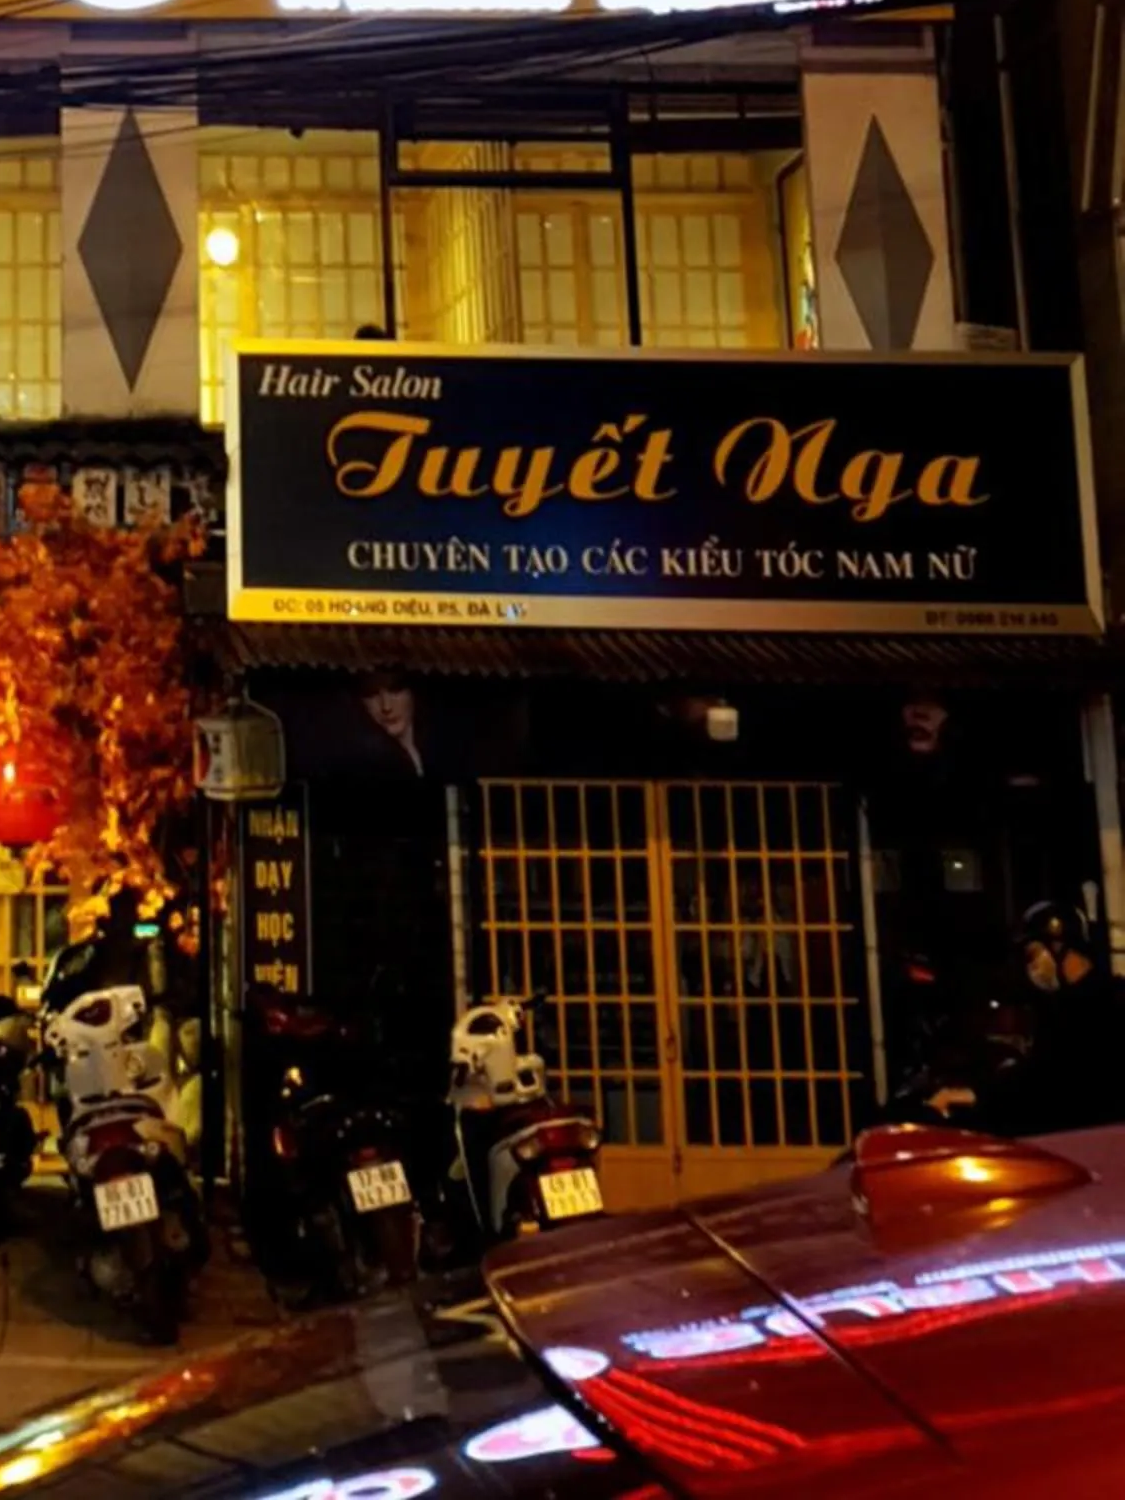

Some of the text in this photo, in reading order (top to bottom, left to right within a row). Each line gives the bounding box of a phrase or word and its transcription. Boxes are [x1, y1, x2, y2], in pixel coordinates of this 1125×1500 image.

[259, 365, 442, 399] Hair Salon
[327, 410, 991, 521] Tuyết Nga
[348, 536, 490, 572] CHUYÊN
[502, 544, 568, 578] TẠO
[581, 538, 649, 575] CÁC
[661, 534, 742, 578] KIỂU
[755, 541, 824, 578] TÓC
[836, 550, 913, 580] NAM
[255, 860, 293, 896] DẠY
[256, 912, 295, 948] HỌC
